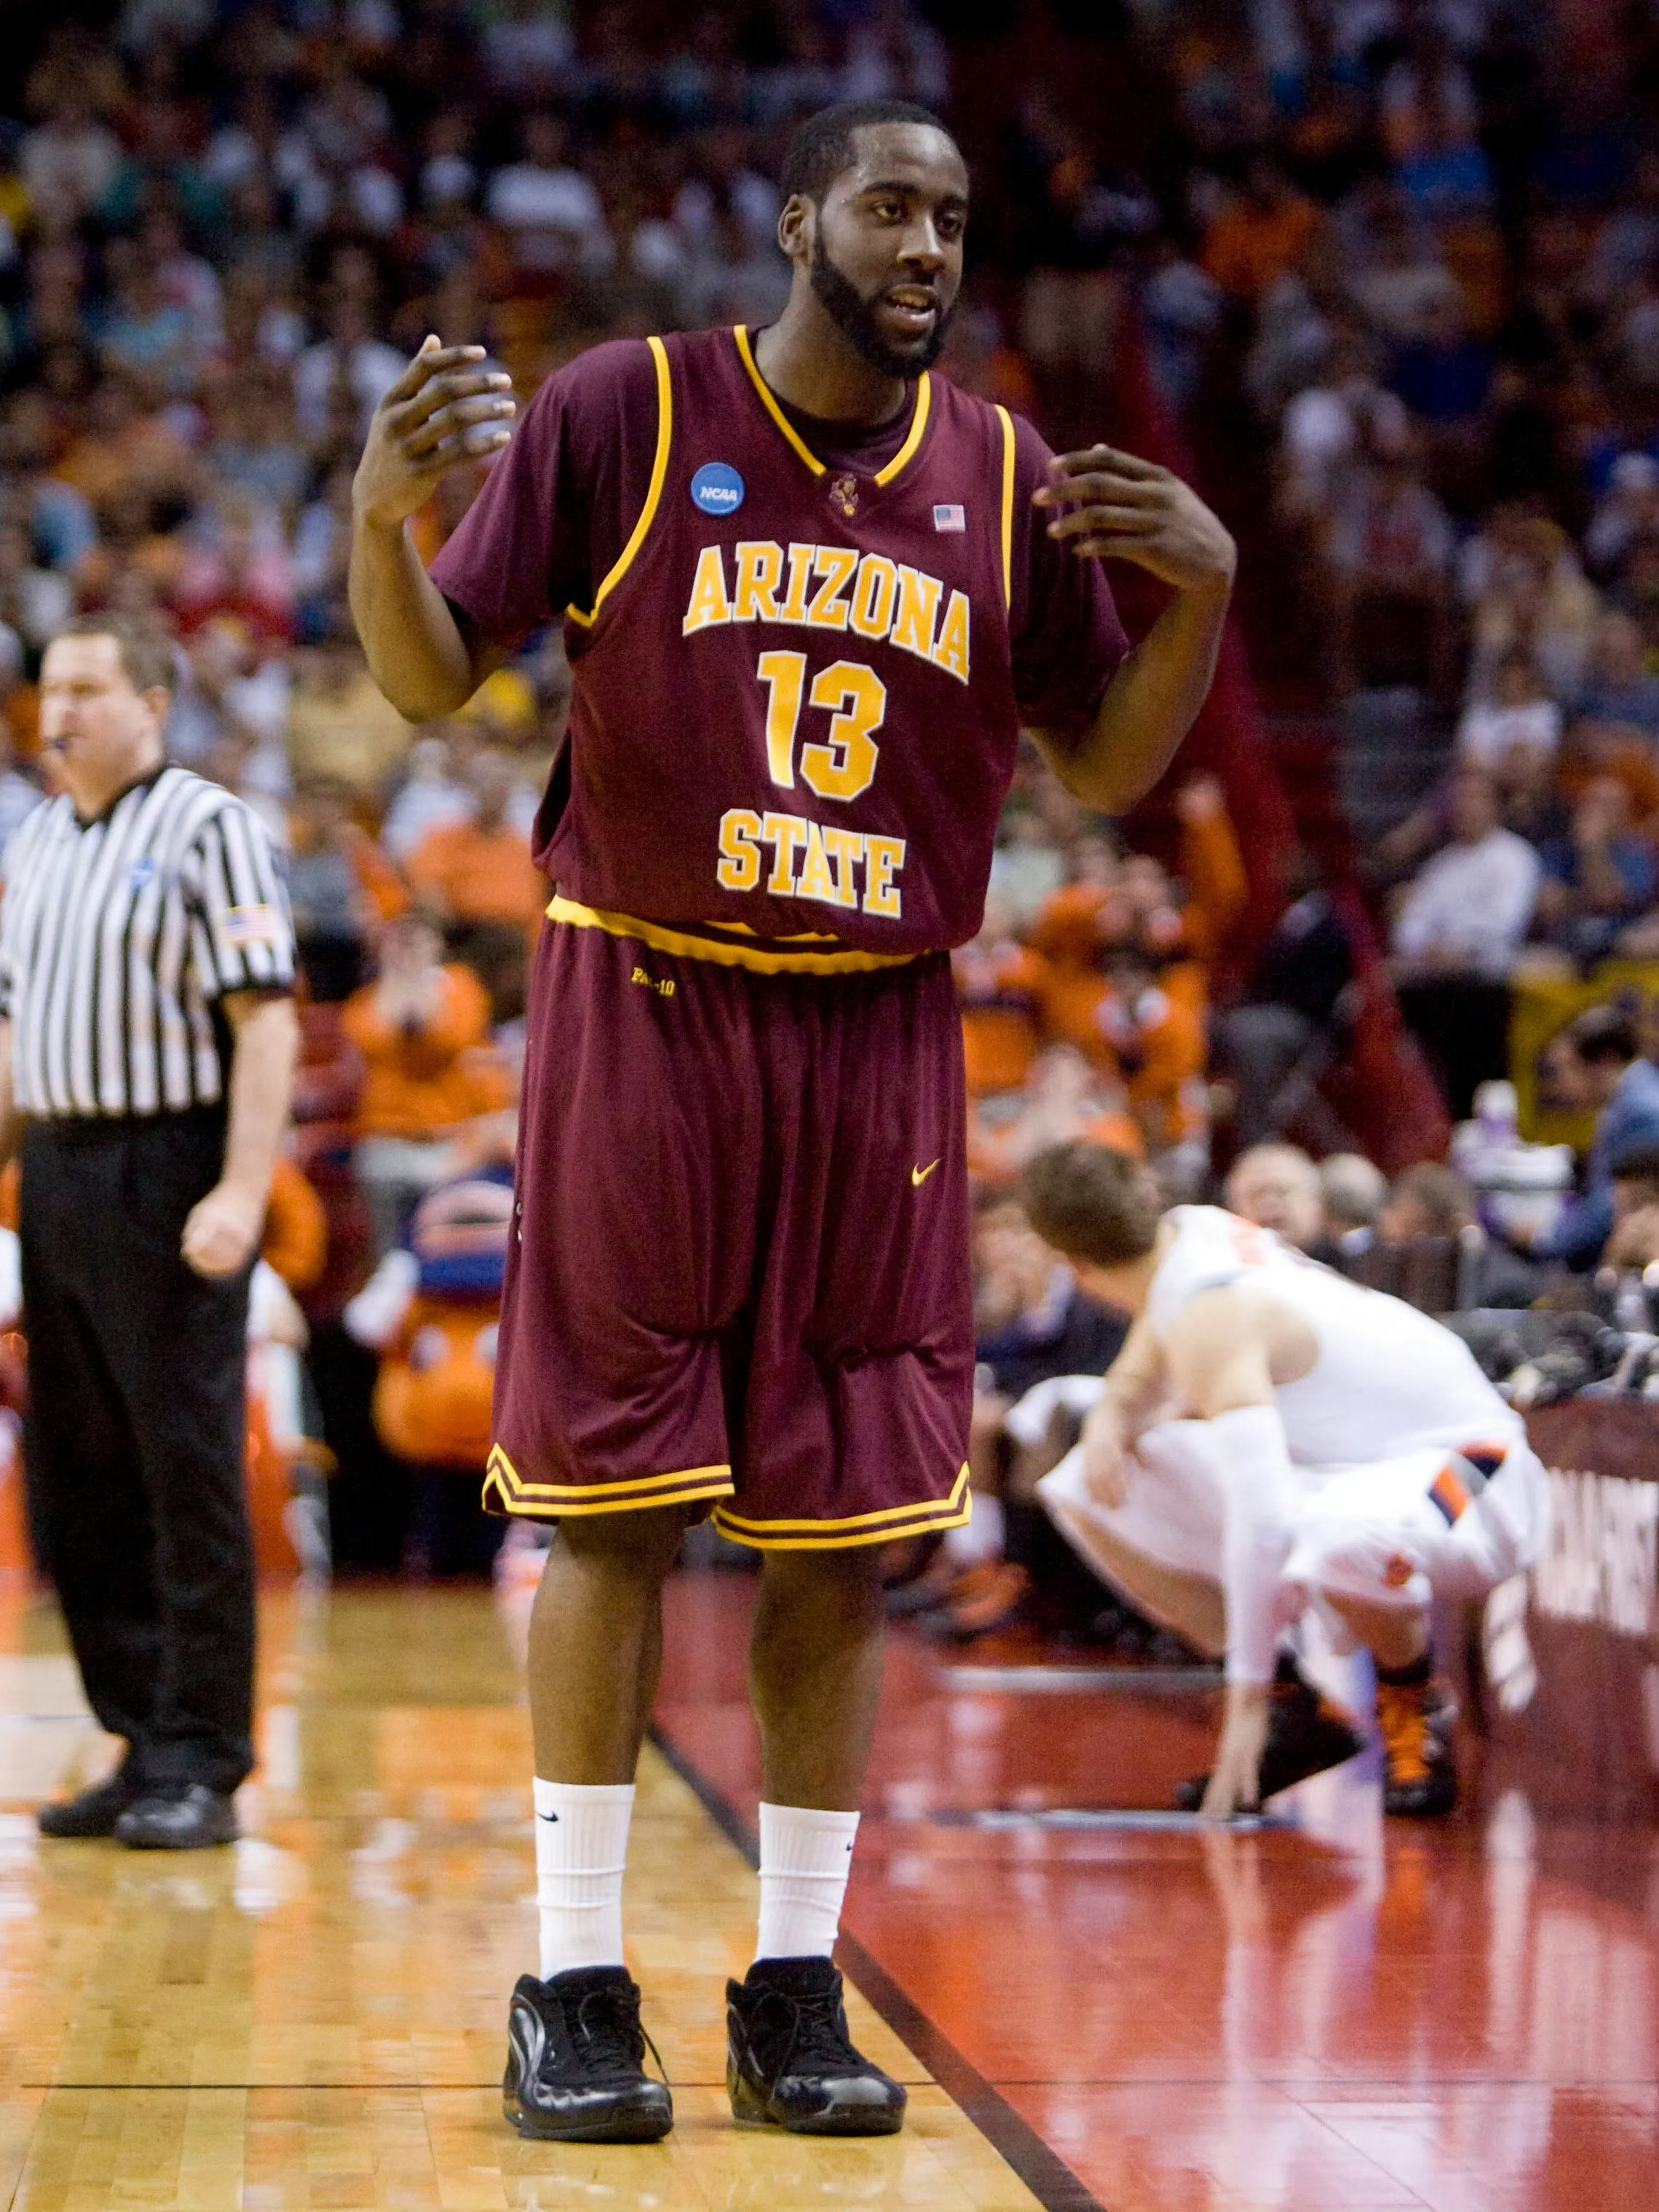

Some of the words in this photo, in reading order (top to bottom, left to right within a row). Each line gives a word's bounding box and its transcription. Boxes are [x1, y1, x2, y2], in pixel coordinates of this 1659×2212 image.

[700, 486, 737, 502] NCAA
[683, 541, 970, 685] ARIZONA
[757, 650, 887, 801] 13
[717, 809, 906, 919] STATE
[631, 967, 676, 996] PA-10
